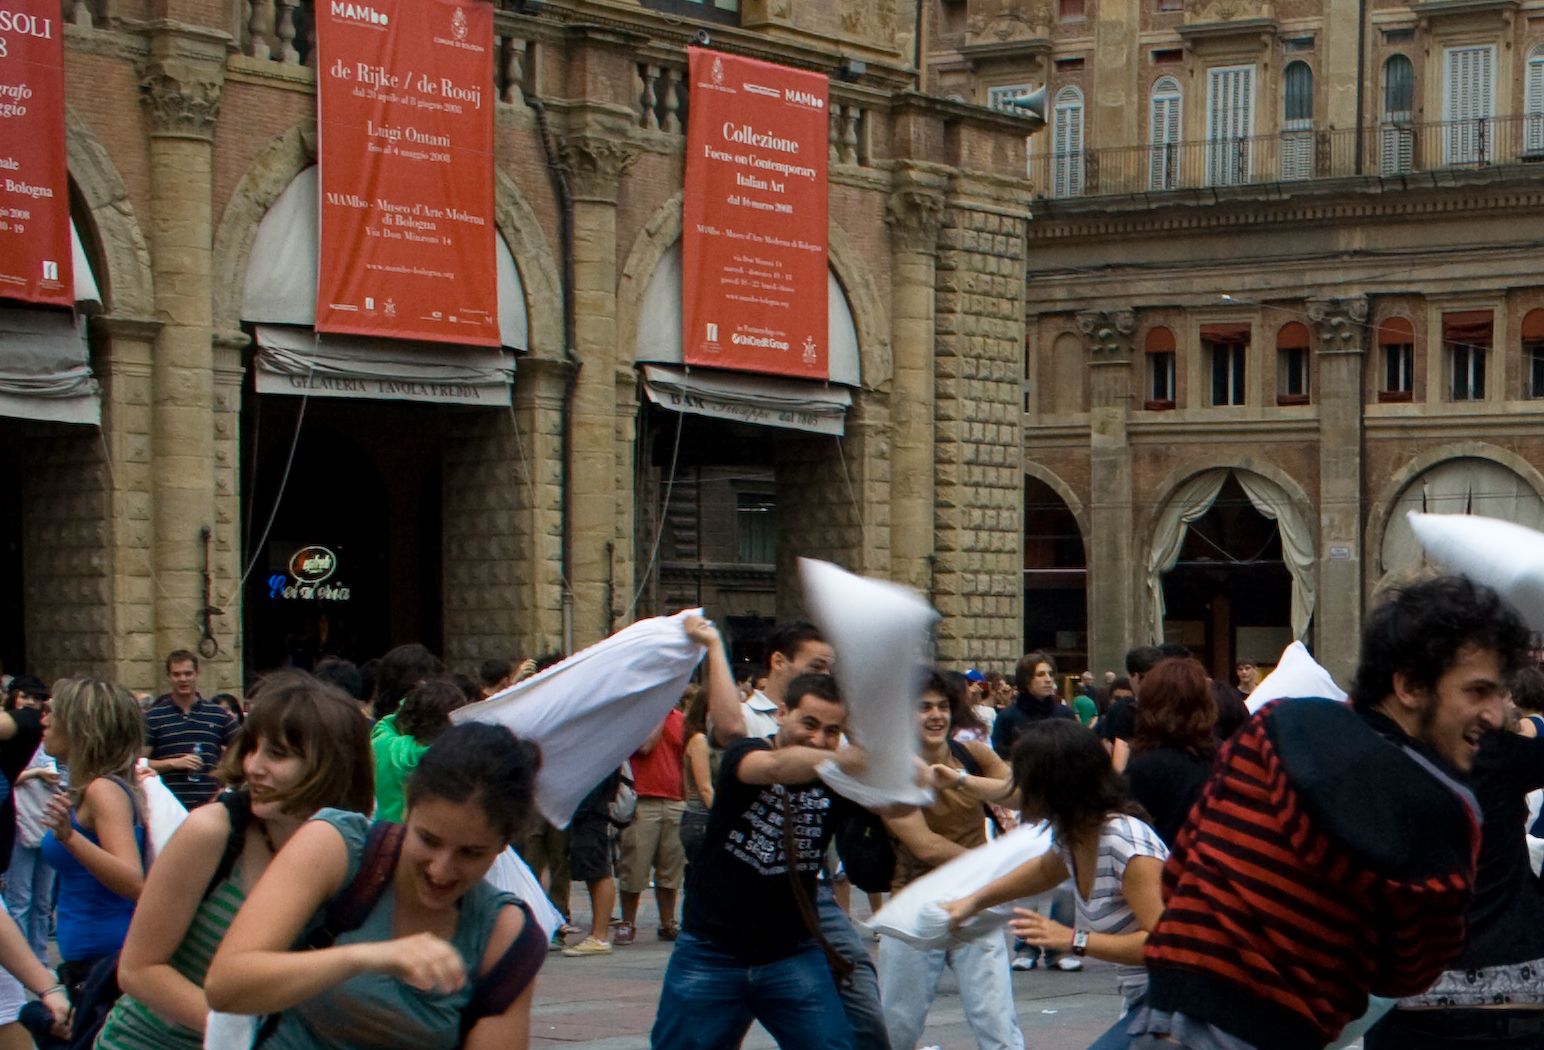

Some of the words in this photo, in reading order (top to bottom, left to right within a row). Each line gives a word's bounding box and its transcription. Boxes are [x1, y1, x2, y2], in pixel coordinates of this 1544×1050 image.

[331, 1, 389, 26] MAMbo
[0, 83, 32, 101] rafo
[331, 58, 351, 80] de
[357, 62, 399, 91] Rijke
[403, 71, 412, 90] /
[417, 74, 438, 95] de
[441, 78, 481, 109] Rooij
[367, 120, 401, 145] Luigi
[405, 126, 451, 148] Ontani
[722, 122, 799, 154] Collezione
[704, 145, 733, 161] Focus
[735, 154, 748, 165] on
[748, 154, 816, 181] Contemporary
[6, 179, 54, 199] Bologna
[736, 172, 768, 191] Italian
[769, 179, 785, 193] Art
[377, 198, 410, 215] Museo
[446, 208, 485, 226] Moderna
[382, 214, 393, 226] di
[395, 214, 437, 231] Bologna
